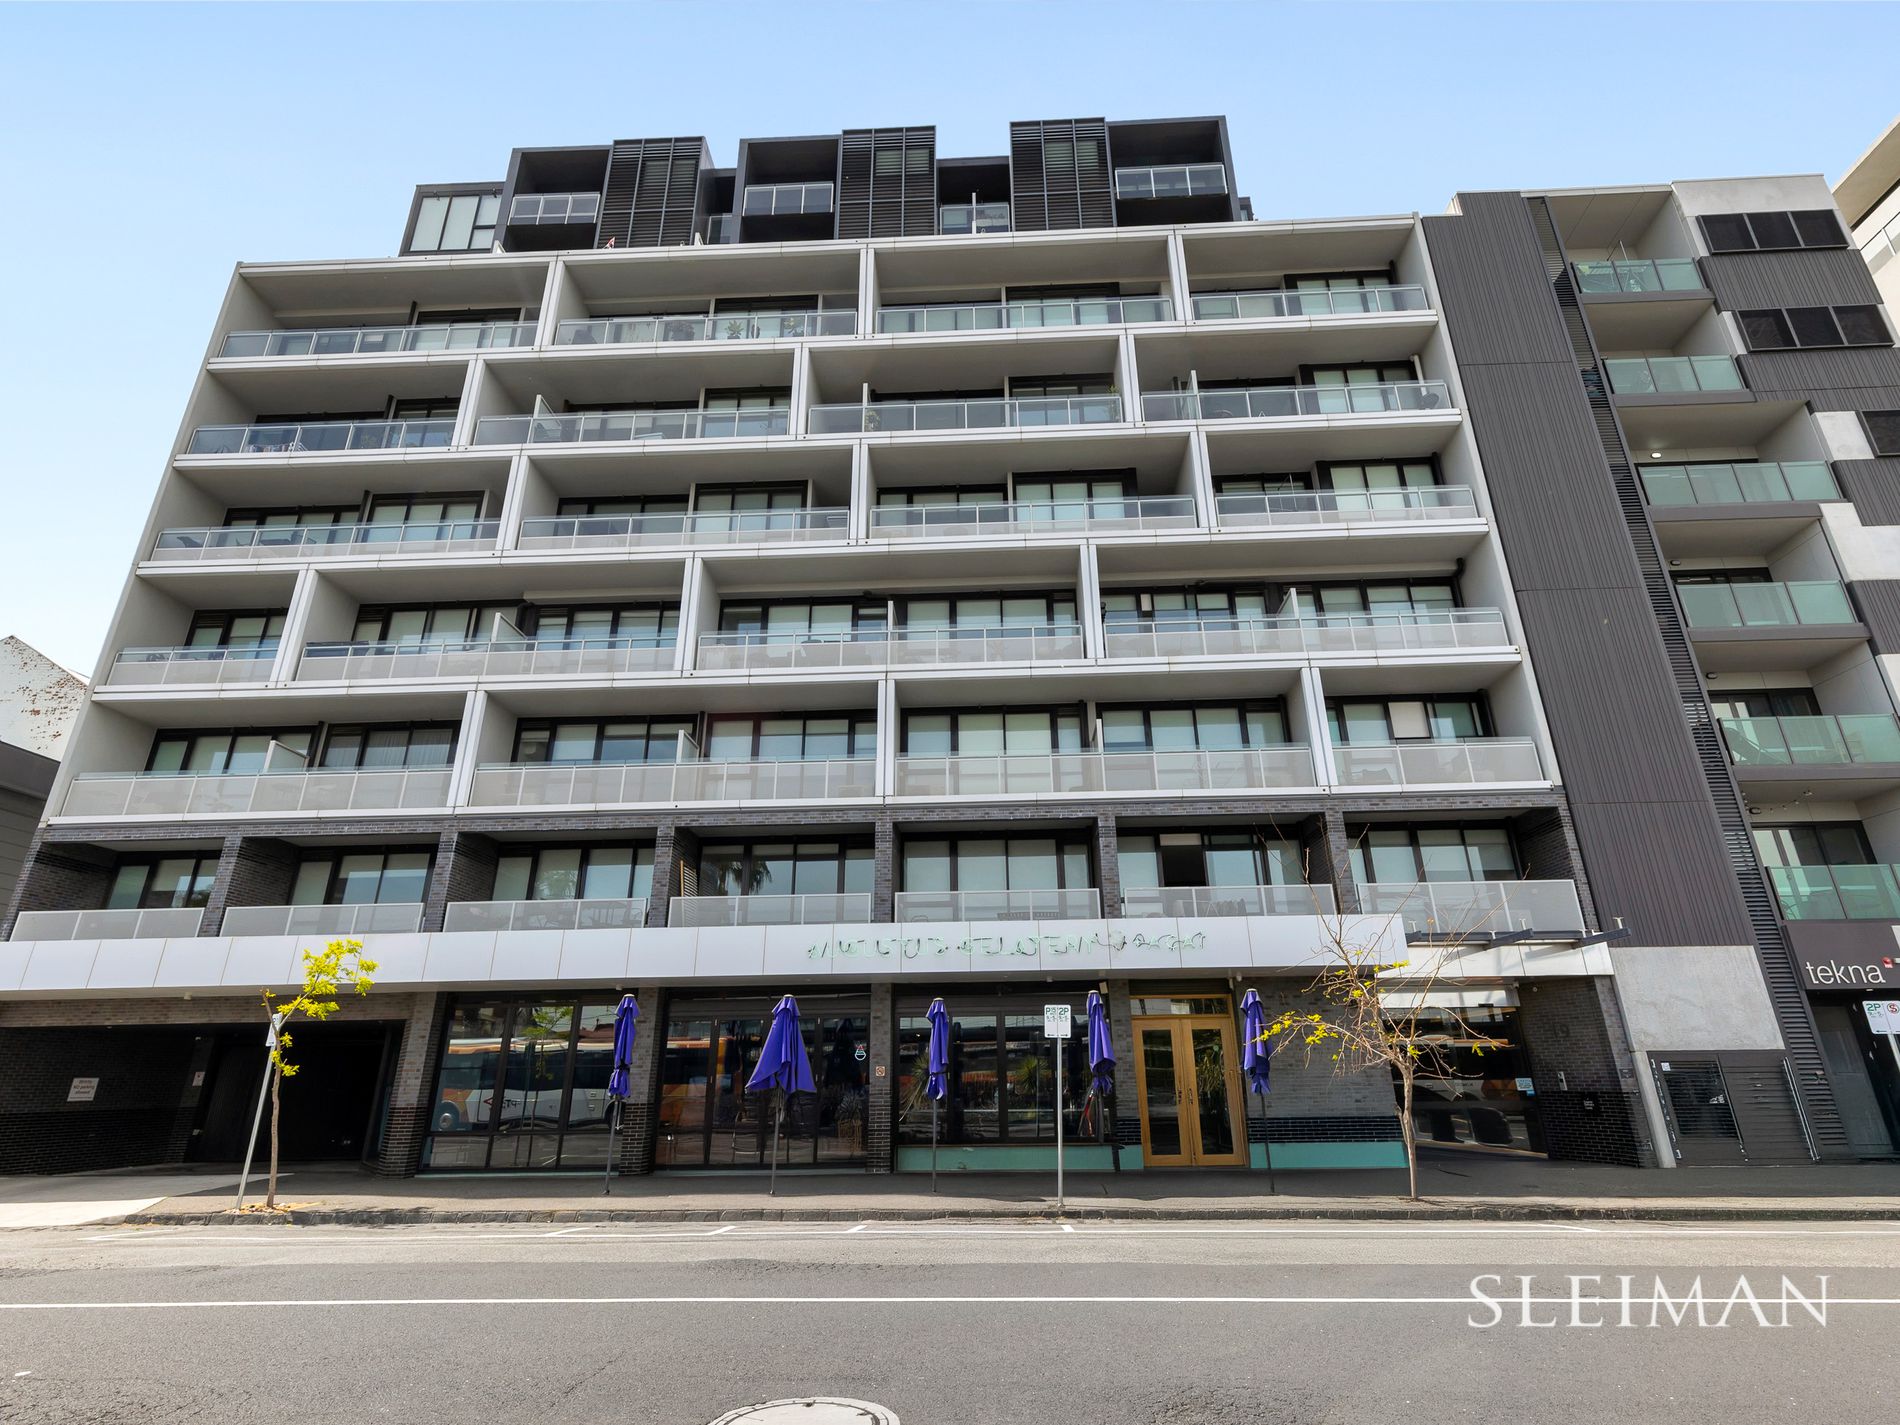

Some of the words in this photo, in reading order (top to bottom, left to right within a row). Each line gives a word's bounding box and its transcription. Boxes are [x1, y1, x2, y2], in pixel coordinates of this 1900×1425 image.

[1805, 960, 1886, 985] tekna
[1059, 1007, 1069, 1015] 2P
[1865, 1003, 1881, 1011] 2P
